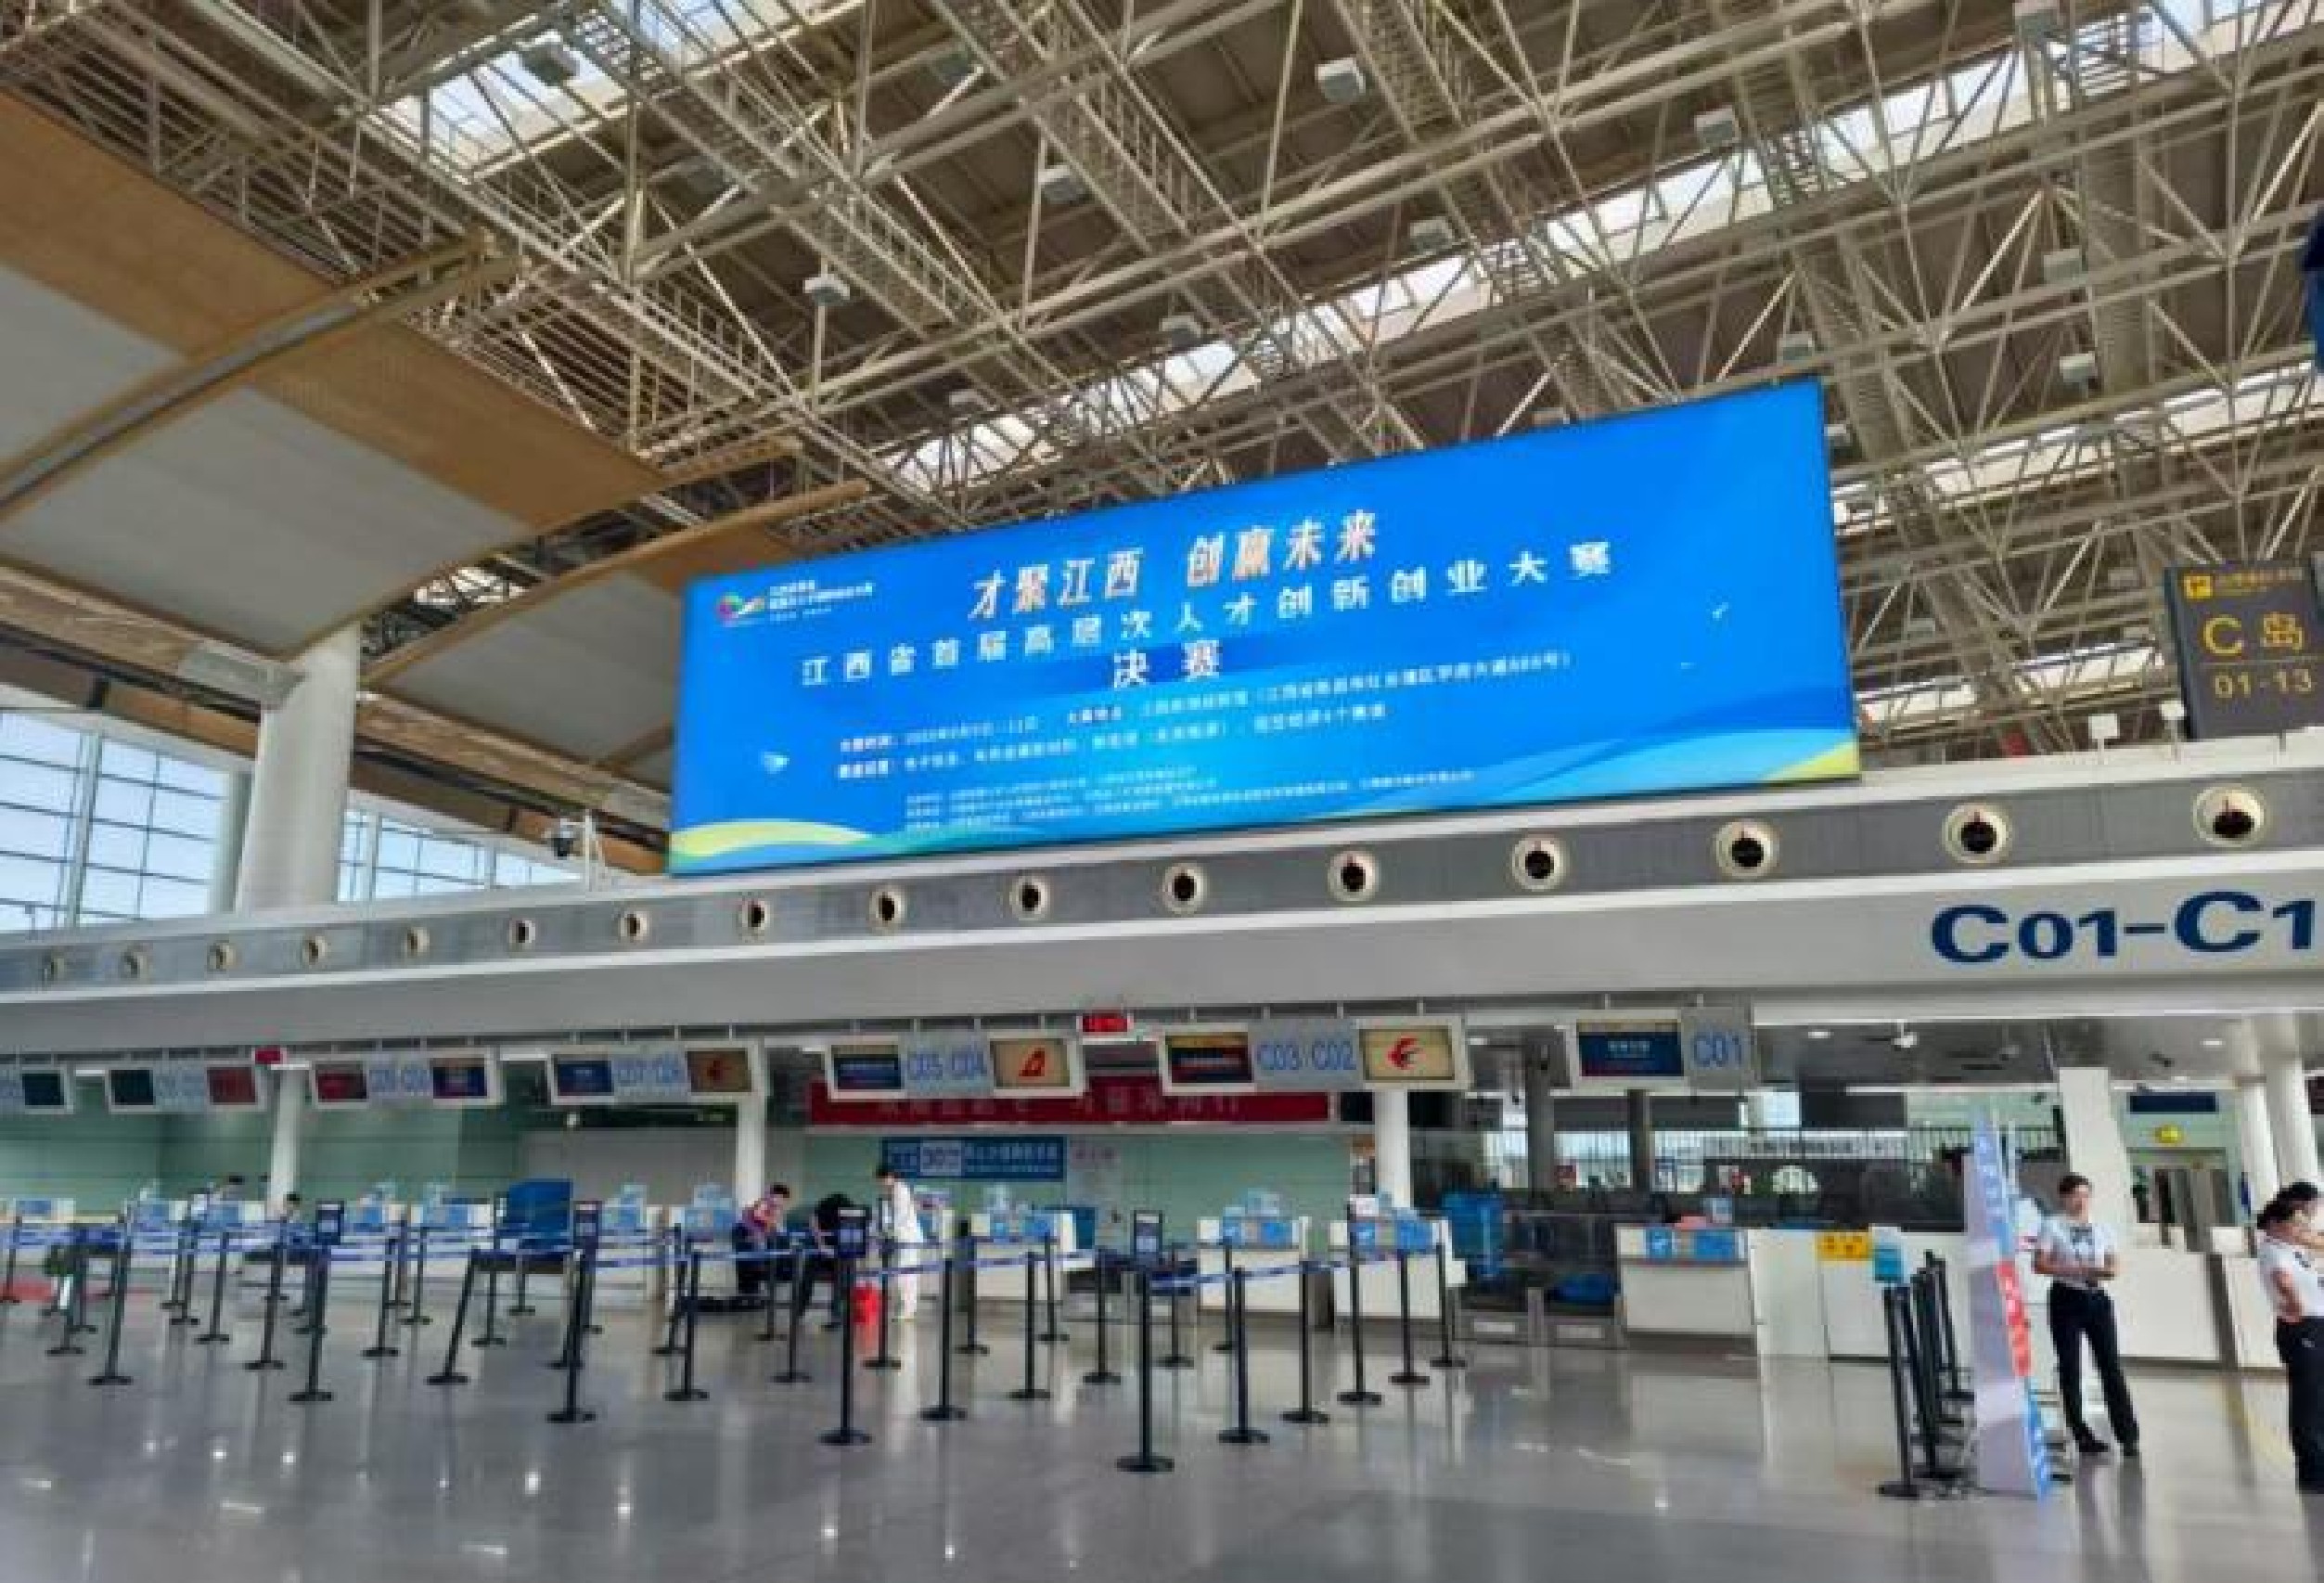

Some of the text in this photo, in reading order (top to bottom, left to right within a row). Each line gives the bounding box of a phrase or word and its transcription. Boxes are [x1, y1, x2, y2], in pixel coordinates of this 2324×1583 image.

[968, 508, 1377, 620] 才聚江西 创赢未来
[1112, 637, 1222, 689] 决赛
[1256, 1040, 1303, 1072] C03
[1311, 1039, 1357, 1071] C02
[1691, 1030, 1743, 1068] C01
